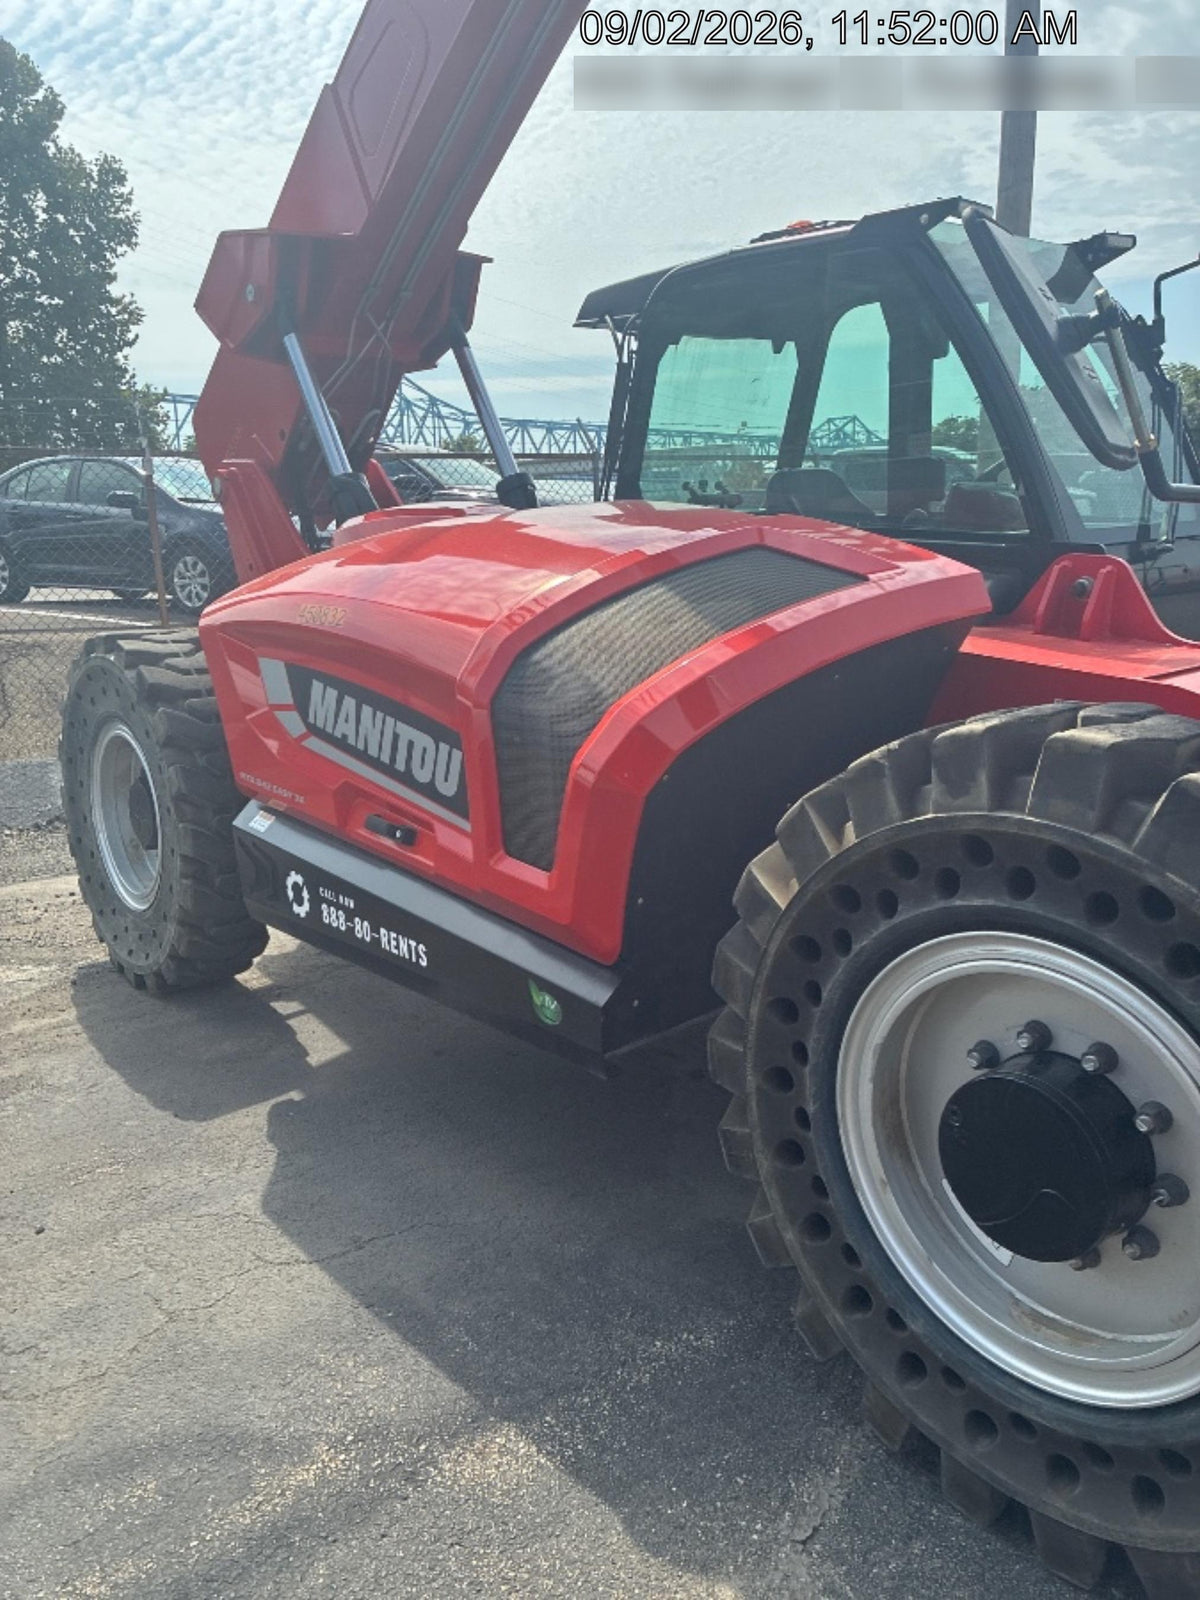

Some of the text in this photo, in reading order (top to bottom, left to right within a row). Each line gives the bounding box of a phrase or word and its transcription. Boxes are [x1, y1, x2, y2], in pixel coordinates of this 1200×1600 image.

[308, 679, 463, 797] MANITOU
[319, 886, 337, 902] CALL
[321, 902, 428, 967] 888-80-RENTS
